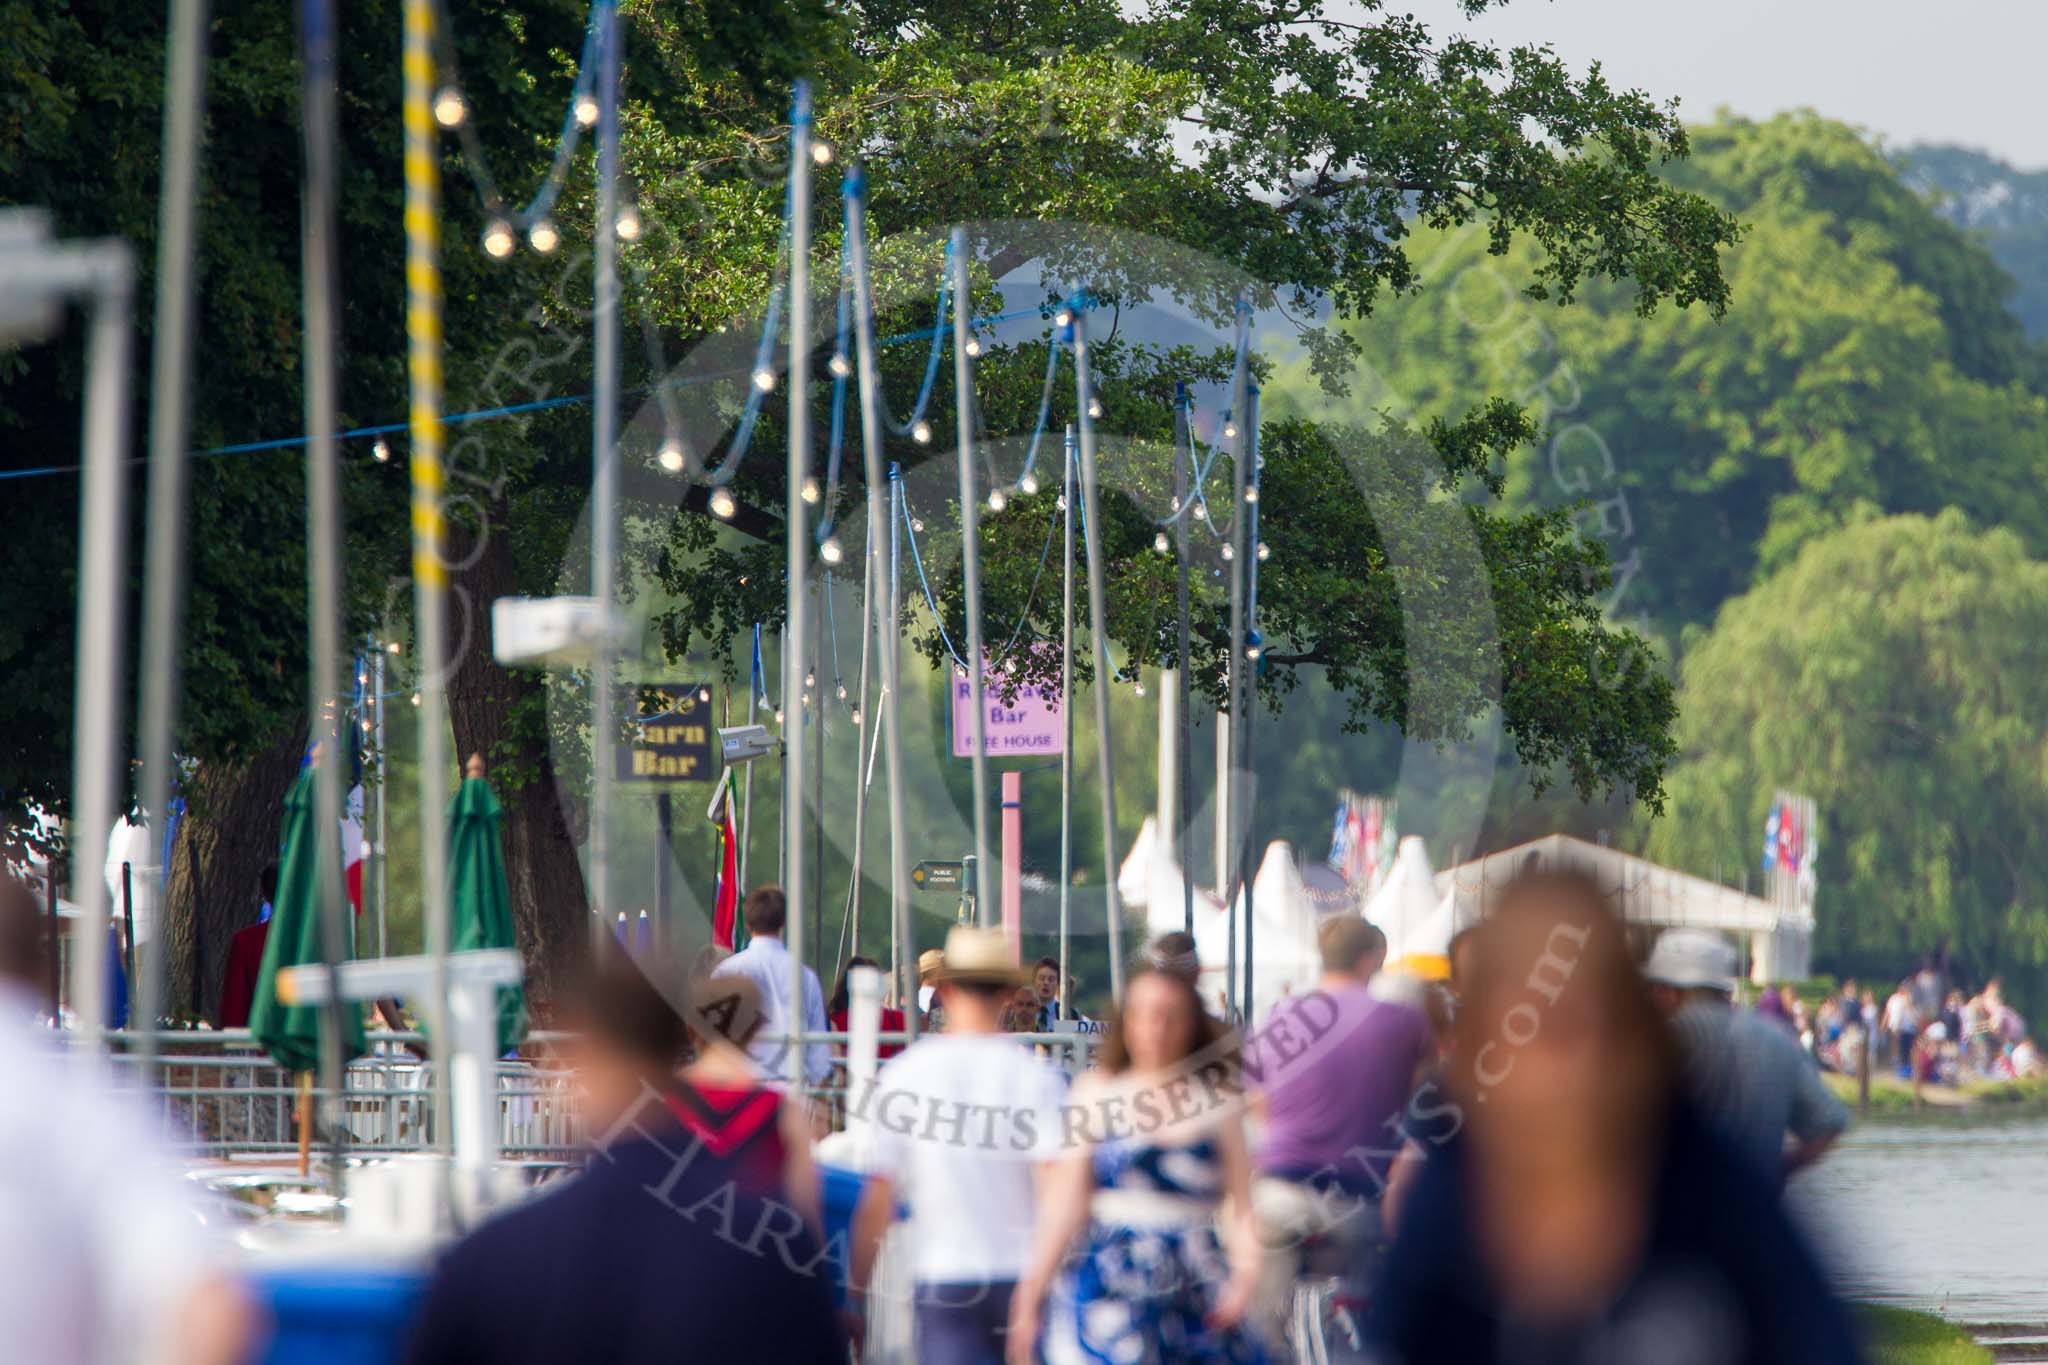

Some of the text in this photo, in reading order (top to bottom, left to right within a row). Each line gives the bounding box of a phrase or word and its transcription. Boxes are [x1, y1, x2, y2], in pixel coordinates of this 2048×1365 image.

[991, 707, 1026, 723] Bar
[621, 722, 705, 746] arn
[965, 735, 1051, 749] FEE HOUSE
[632, 750, 697, 776] Bar
